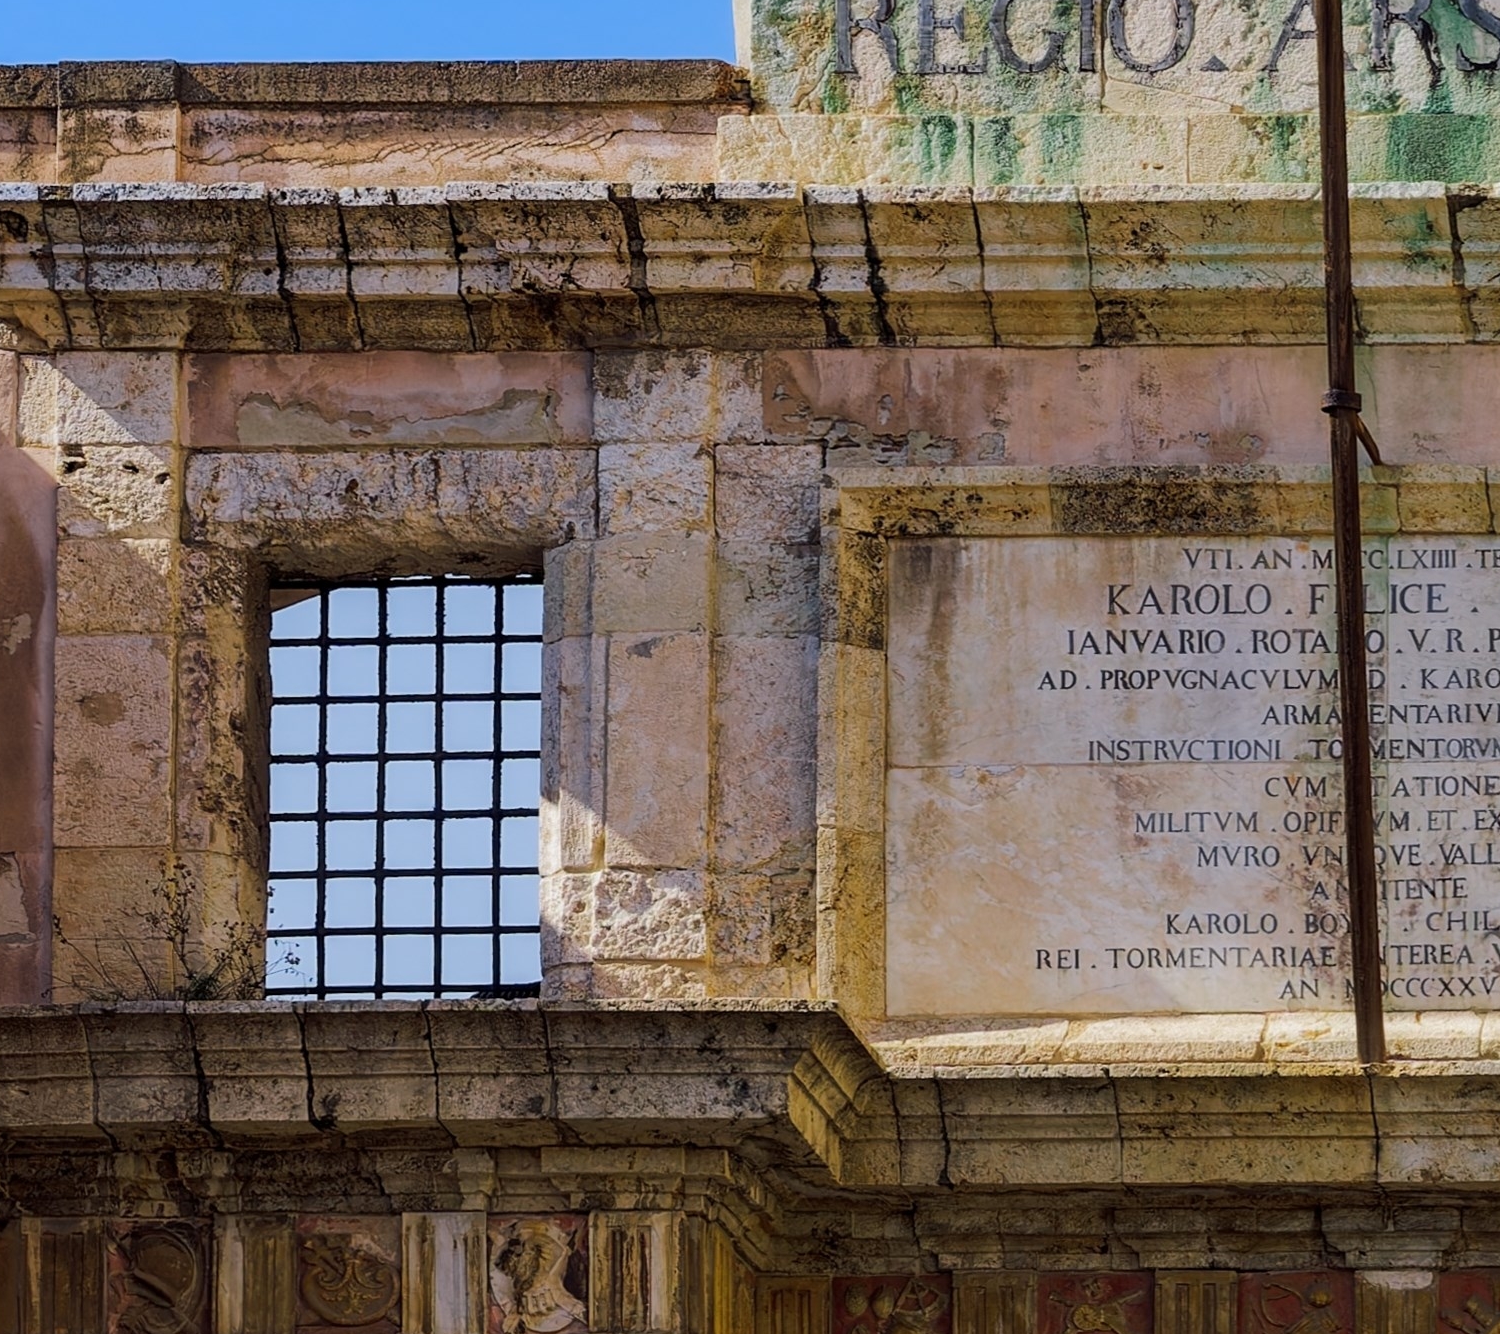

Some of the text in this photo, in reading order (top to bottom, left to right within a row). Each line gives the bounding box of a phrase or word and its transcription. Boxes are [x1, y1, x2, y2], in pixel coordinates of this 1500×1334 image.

[1309, 583, 1449, 615] FLICE
[1252, 628, 1385, 654] ROTAO
[1100, 668, 1339, 690] PROPVGNACVLVM
[1088, 739, 1281, 761] INSTRVCTIONI
[1283, 810, 1410, 833] OPIFVM
[1302, 844, 1421, 871] VNQVE
[1311, 877, 1468, 900] ANITENTE
[1105, 946, 1337, 969] TORMENTARIAE
